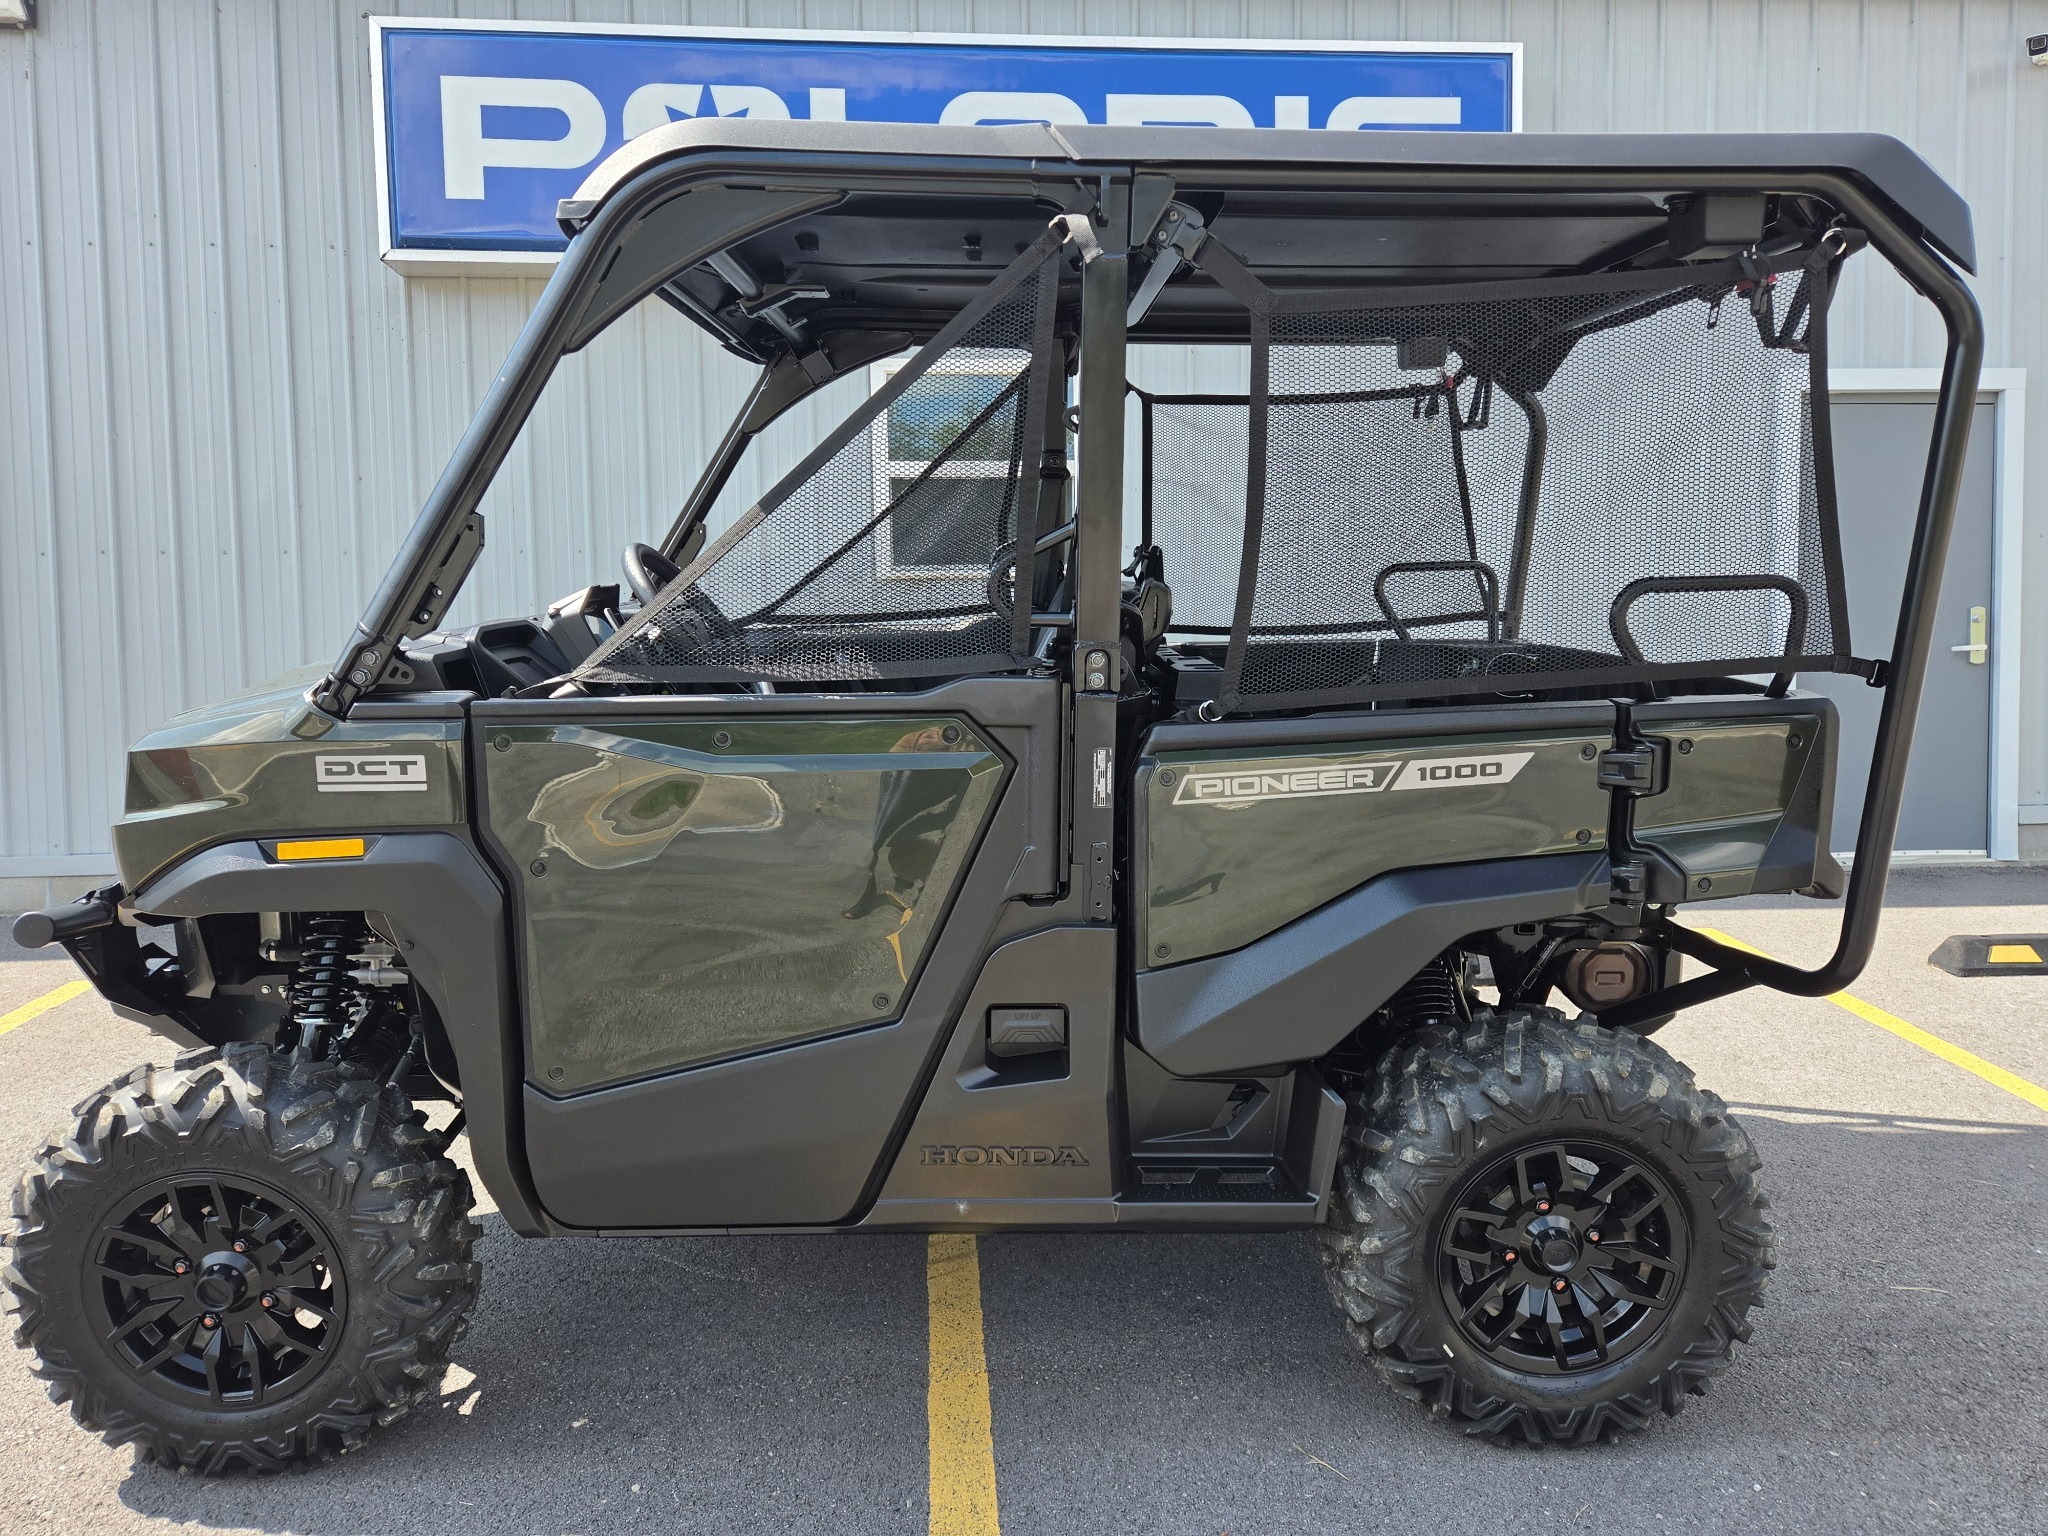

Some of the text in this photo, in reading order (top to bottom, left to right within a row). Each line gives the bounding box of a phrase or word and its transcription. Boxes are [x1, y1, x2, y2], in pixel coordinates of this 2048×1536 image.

[323, 760, 418, 777] DCT
[1194, 761, 1504, 798] PIONEER 1000
[920, 1144, 1090, 1167] HONDA
